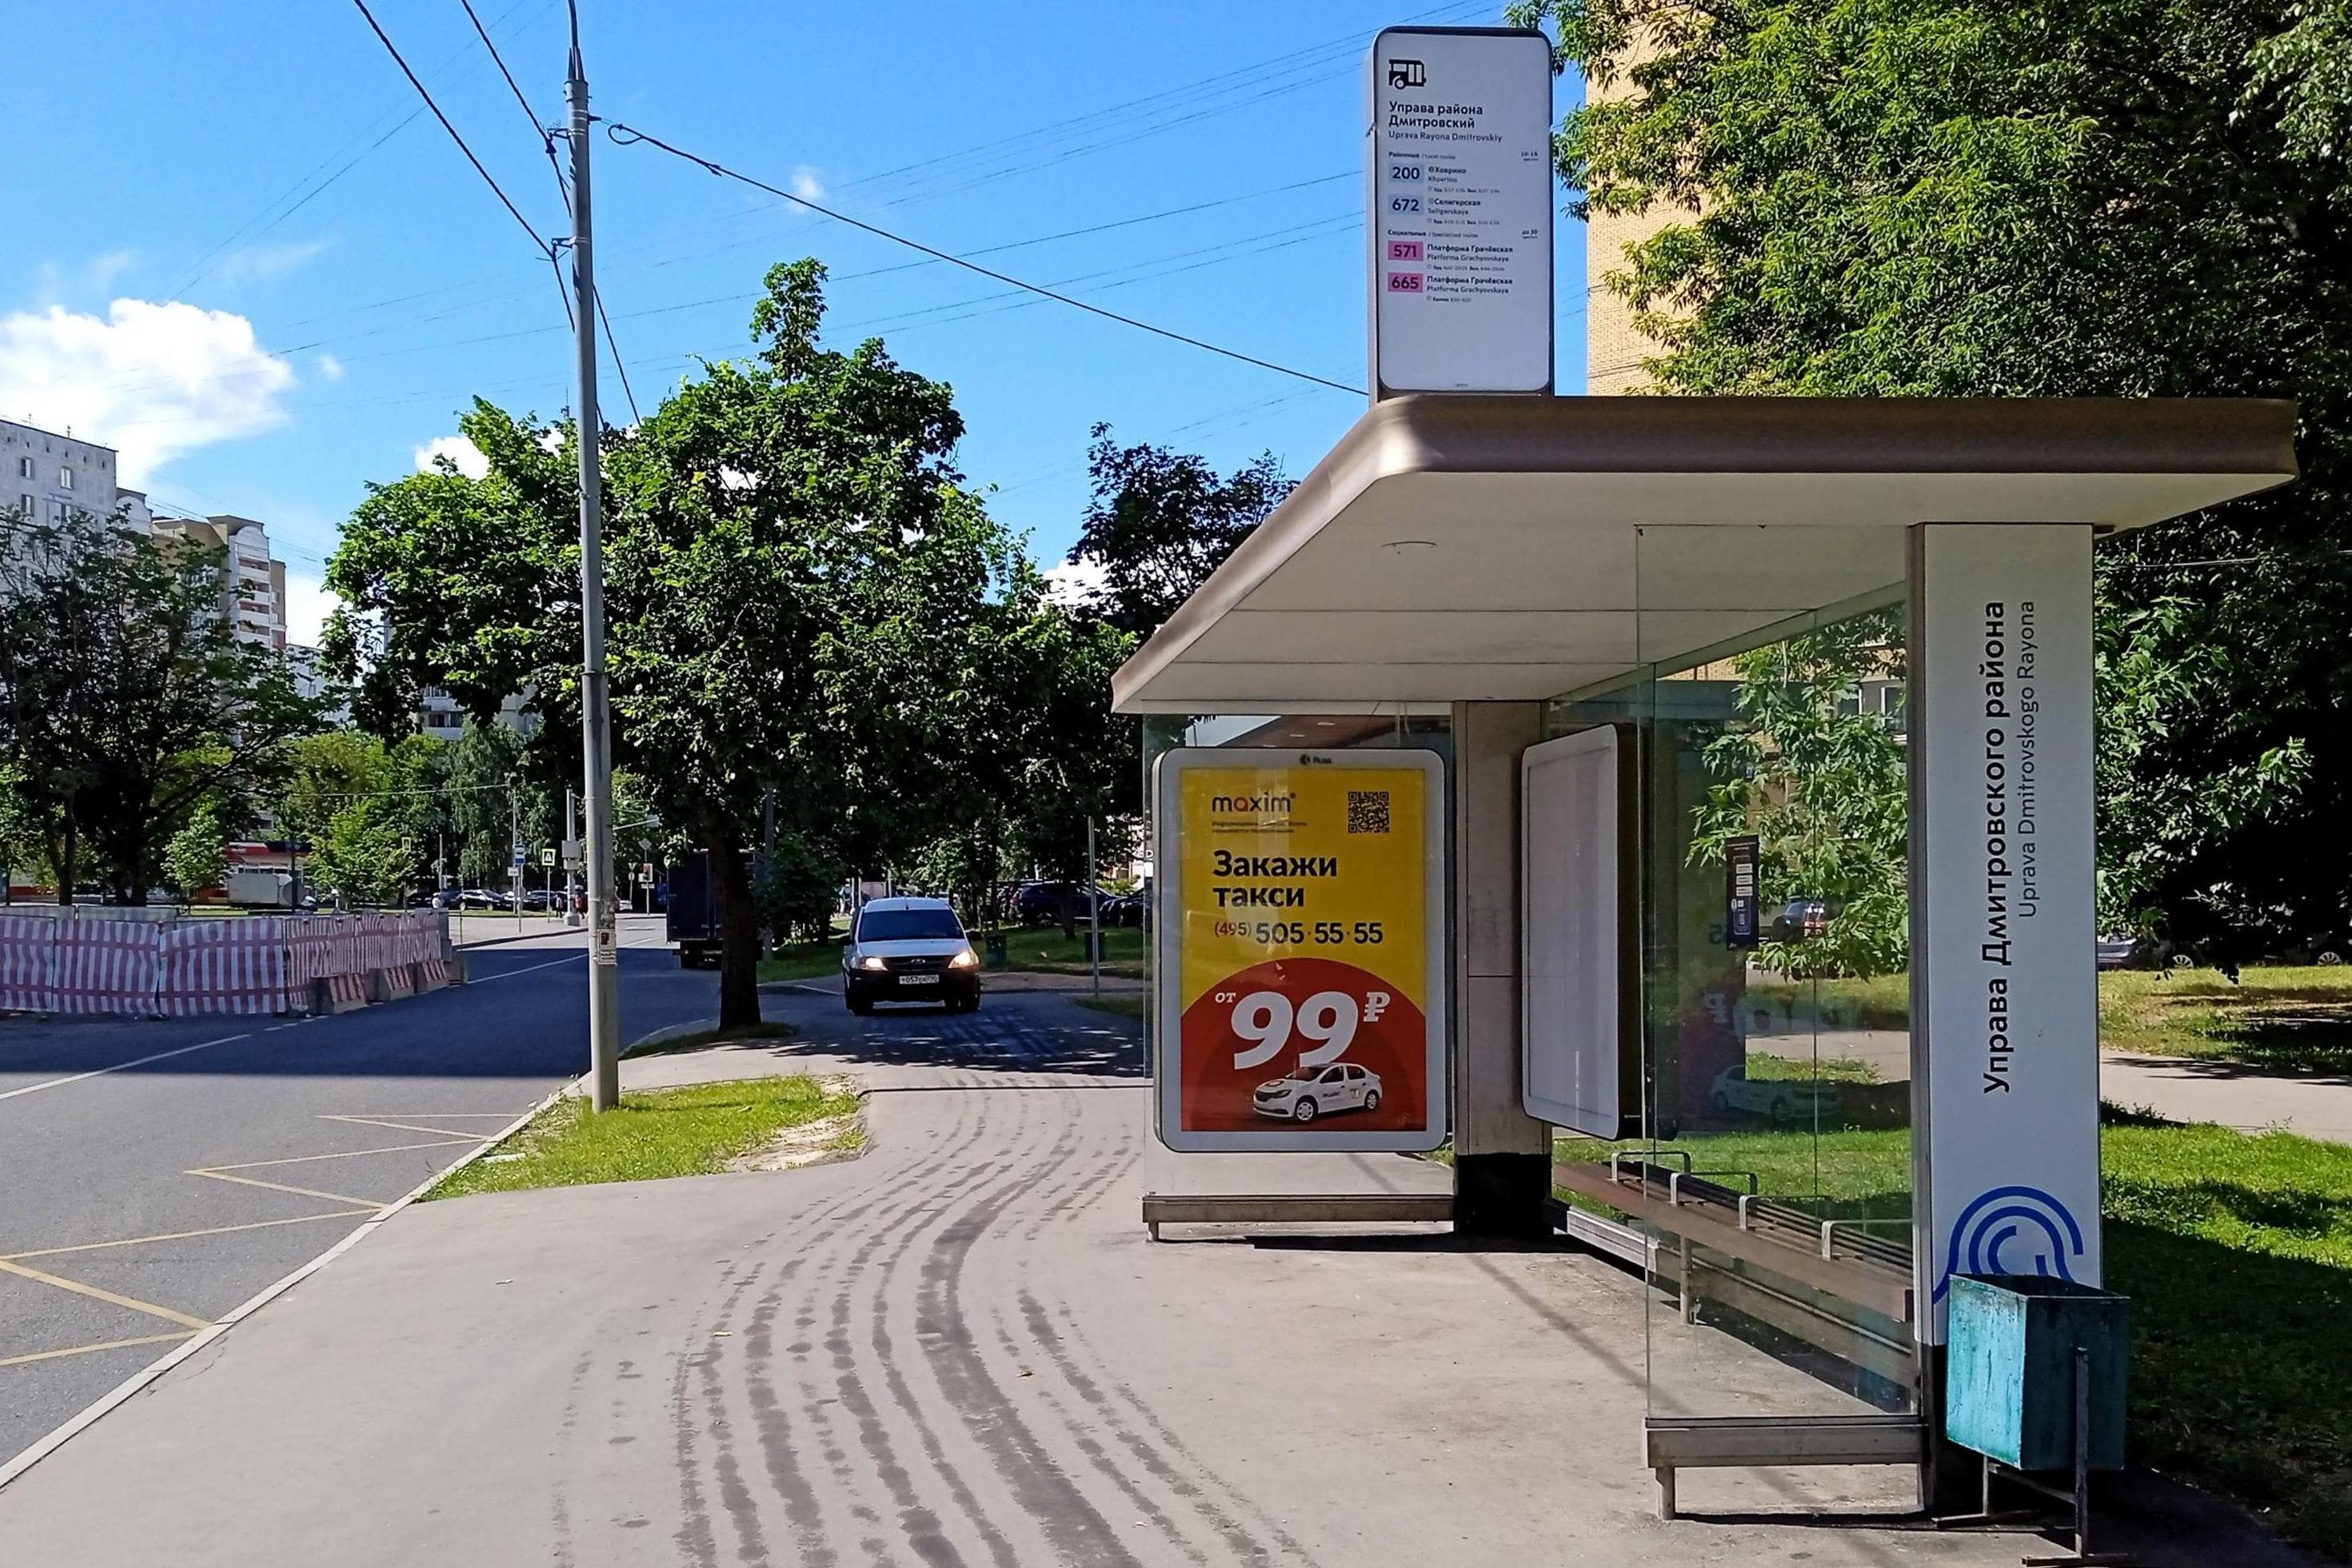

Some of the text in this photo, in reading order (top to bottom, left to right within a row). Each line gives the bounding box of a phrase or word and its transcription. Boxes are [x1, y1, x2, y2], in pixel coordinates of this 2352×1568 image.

[1389, 101, 1483, 116] Управа района
[1388, 114, 1475, 130] Дмитровский
[1388, 130, 1503, 142] Uprava Rayona Dmitrovskiy
[1392, 166, 1420, 180] 200
[1392, 198, 1420, 212] 672
[1434, 198, 1481, 207] Селигерская
[1394, 244, 1417, 257] 571
[1427, 244, 1470, 253] Платформа
[1460, 254, 1509, 263] Grachyovskaya
[1392, 276, 1419, 289] 665
[1427, 276, 1470, 285] Платформа
[1460, 286, 1509, 295] Grachyovskaya
[2016, 601, 2040, 917] Uprava Dmitrovskogo Rayona
[1212, 791, 1292, 812] maxim
[1979, 601, 2015, 1095] Управа Дмитровского района
[1212, 849, 1337, 877] Закажи
[1212, 887, 1304, 908] такси
[1214, 920, 1252, 938] (495)
[1215, 991, 1236, 1003] от
[1231, 991, 1359, 1070] 99
